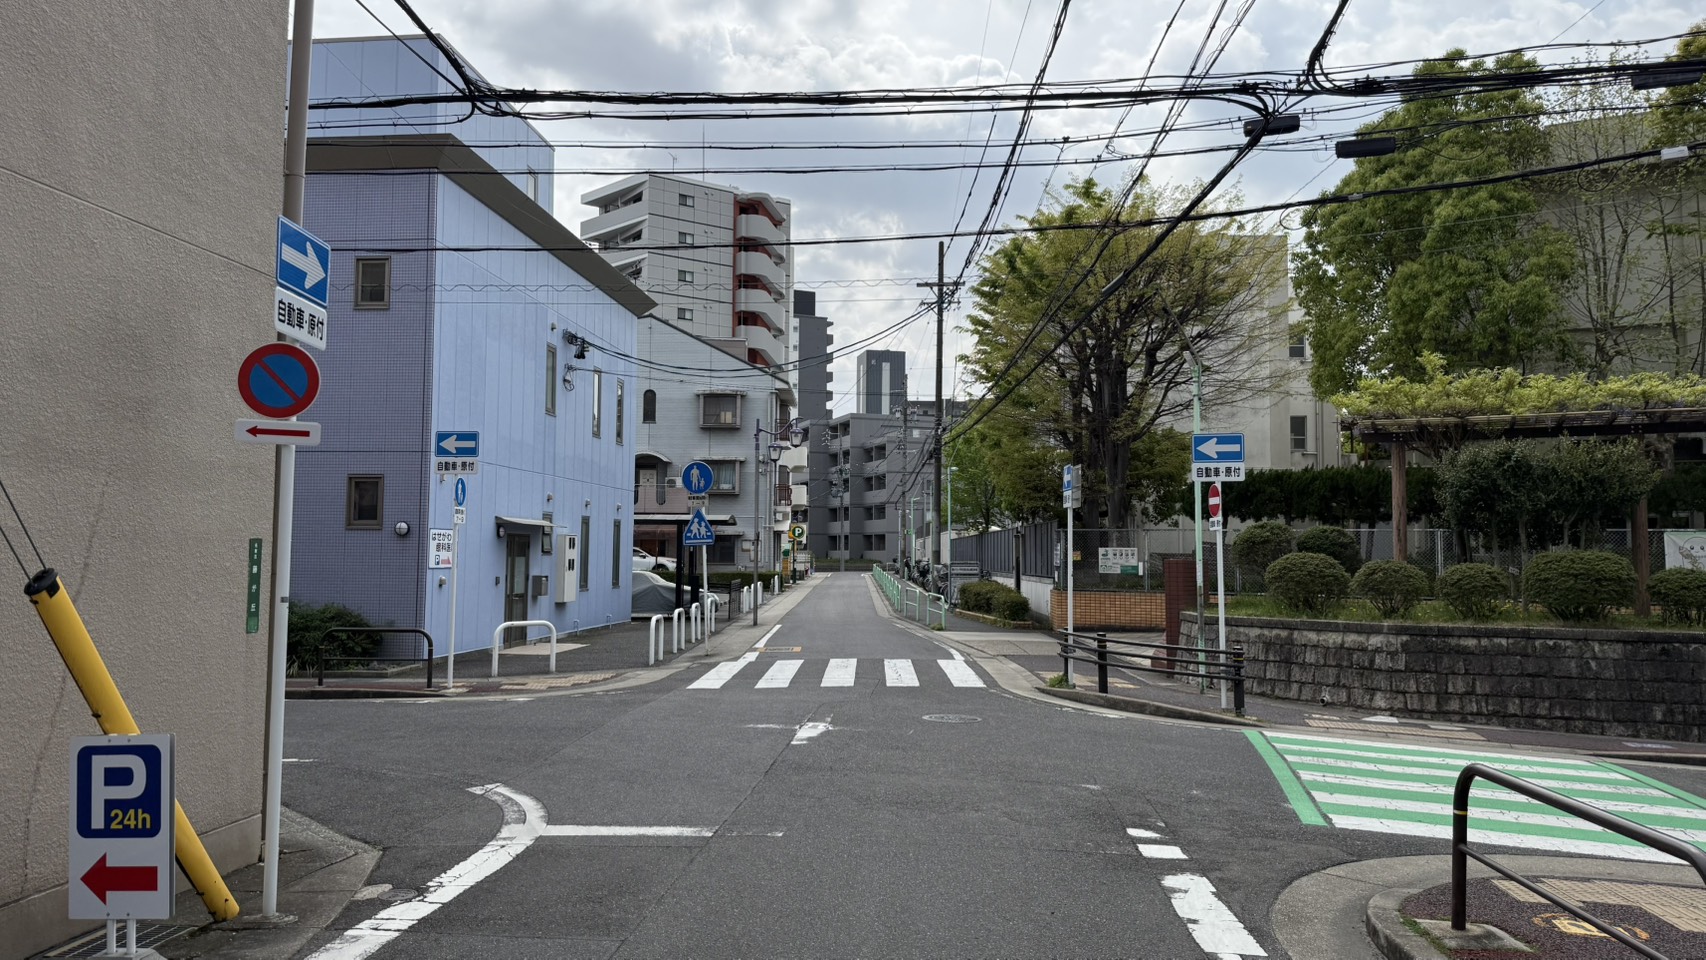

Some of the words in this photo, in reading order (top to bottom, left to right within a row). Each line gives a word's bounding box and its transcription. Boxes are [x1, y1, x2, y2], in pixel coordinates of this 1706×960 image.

[278, 298, 324, 341] 自動車・原付
[437, 461, 475, 471] 自動車・原付
[1196, 466, 1241, 478] 自動車・原付
[432, 532, 452, 542] はせがわ
[795, 527, 802, 537] P
[91, 754, 147, 830] P
[110, 808, 151, 830] 24h
